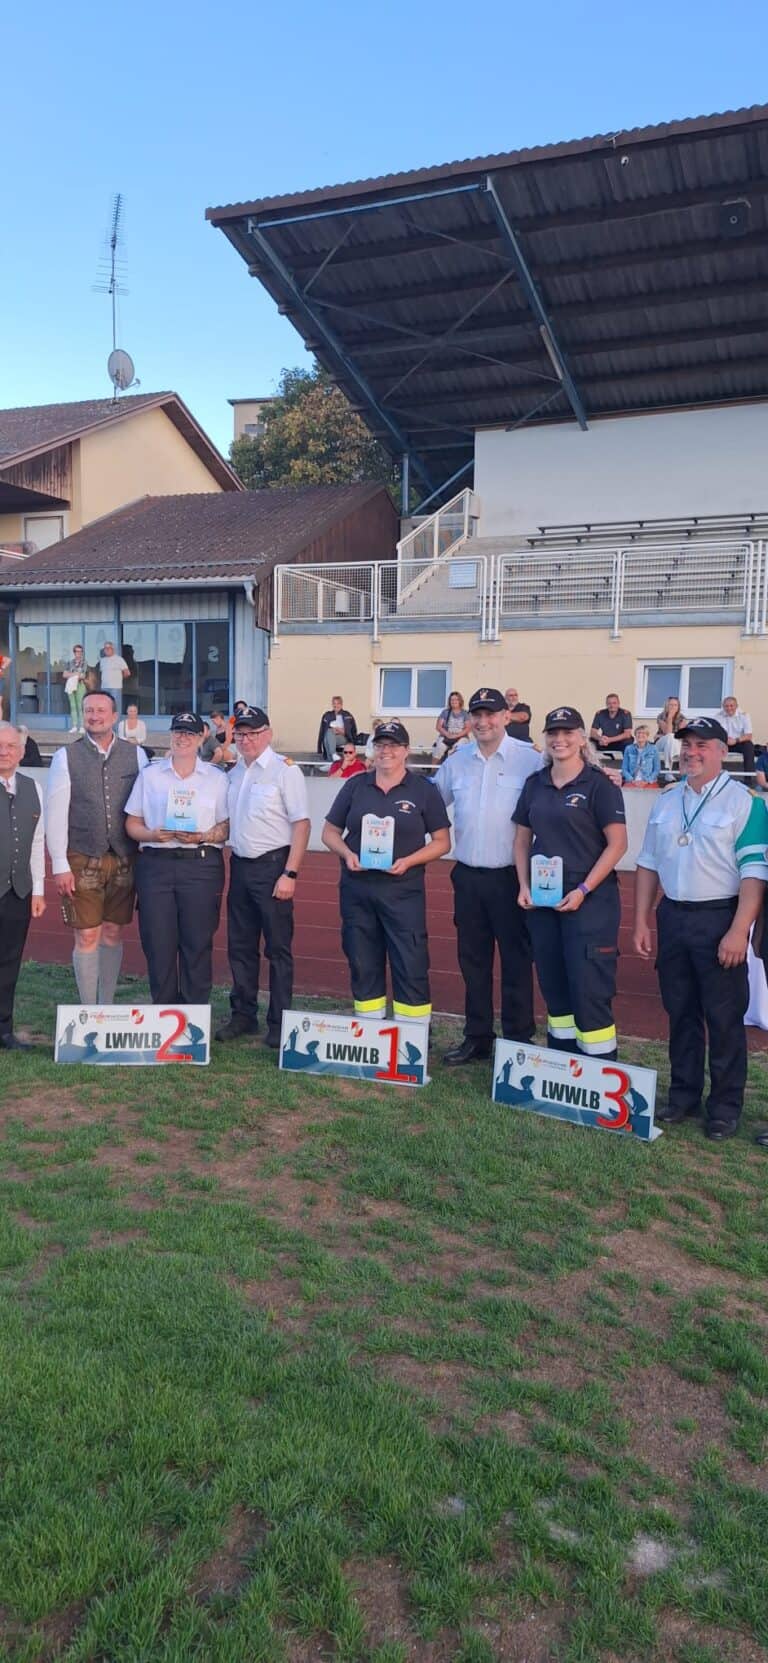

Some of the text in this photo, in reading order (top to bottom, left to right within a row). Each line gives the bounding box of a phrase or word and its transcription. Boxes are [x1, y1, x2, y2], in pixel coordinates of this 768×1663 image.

[105, 1032, 161, 1049] LWWLB
[326, 1042, 380, 1064] LWWLB
[541, 1080, 601, 1110] LWWLB
